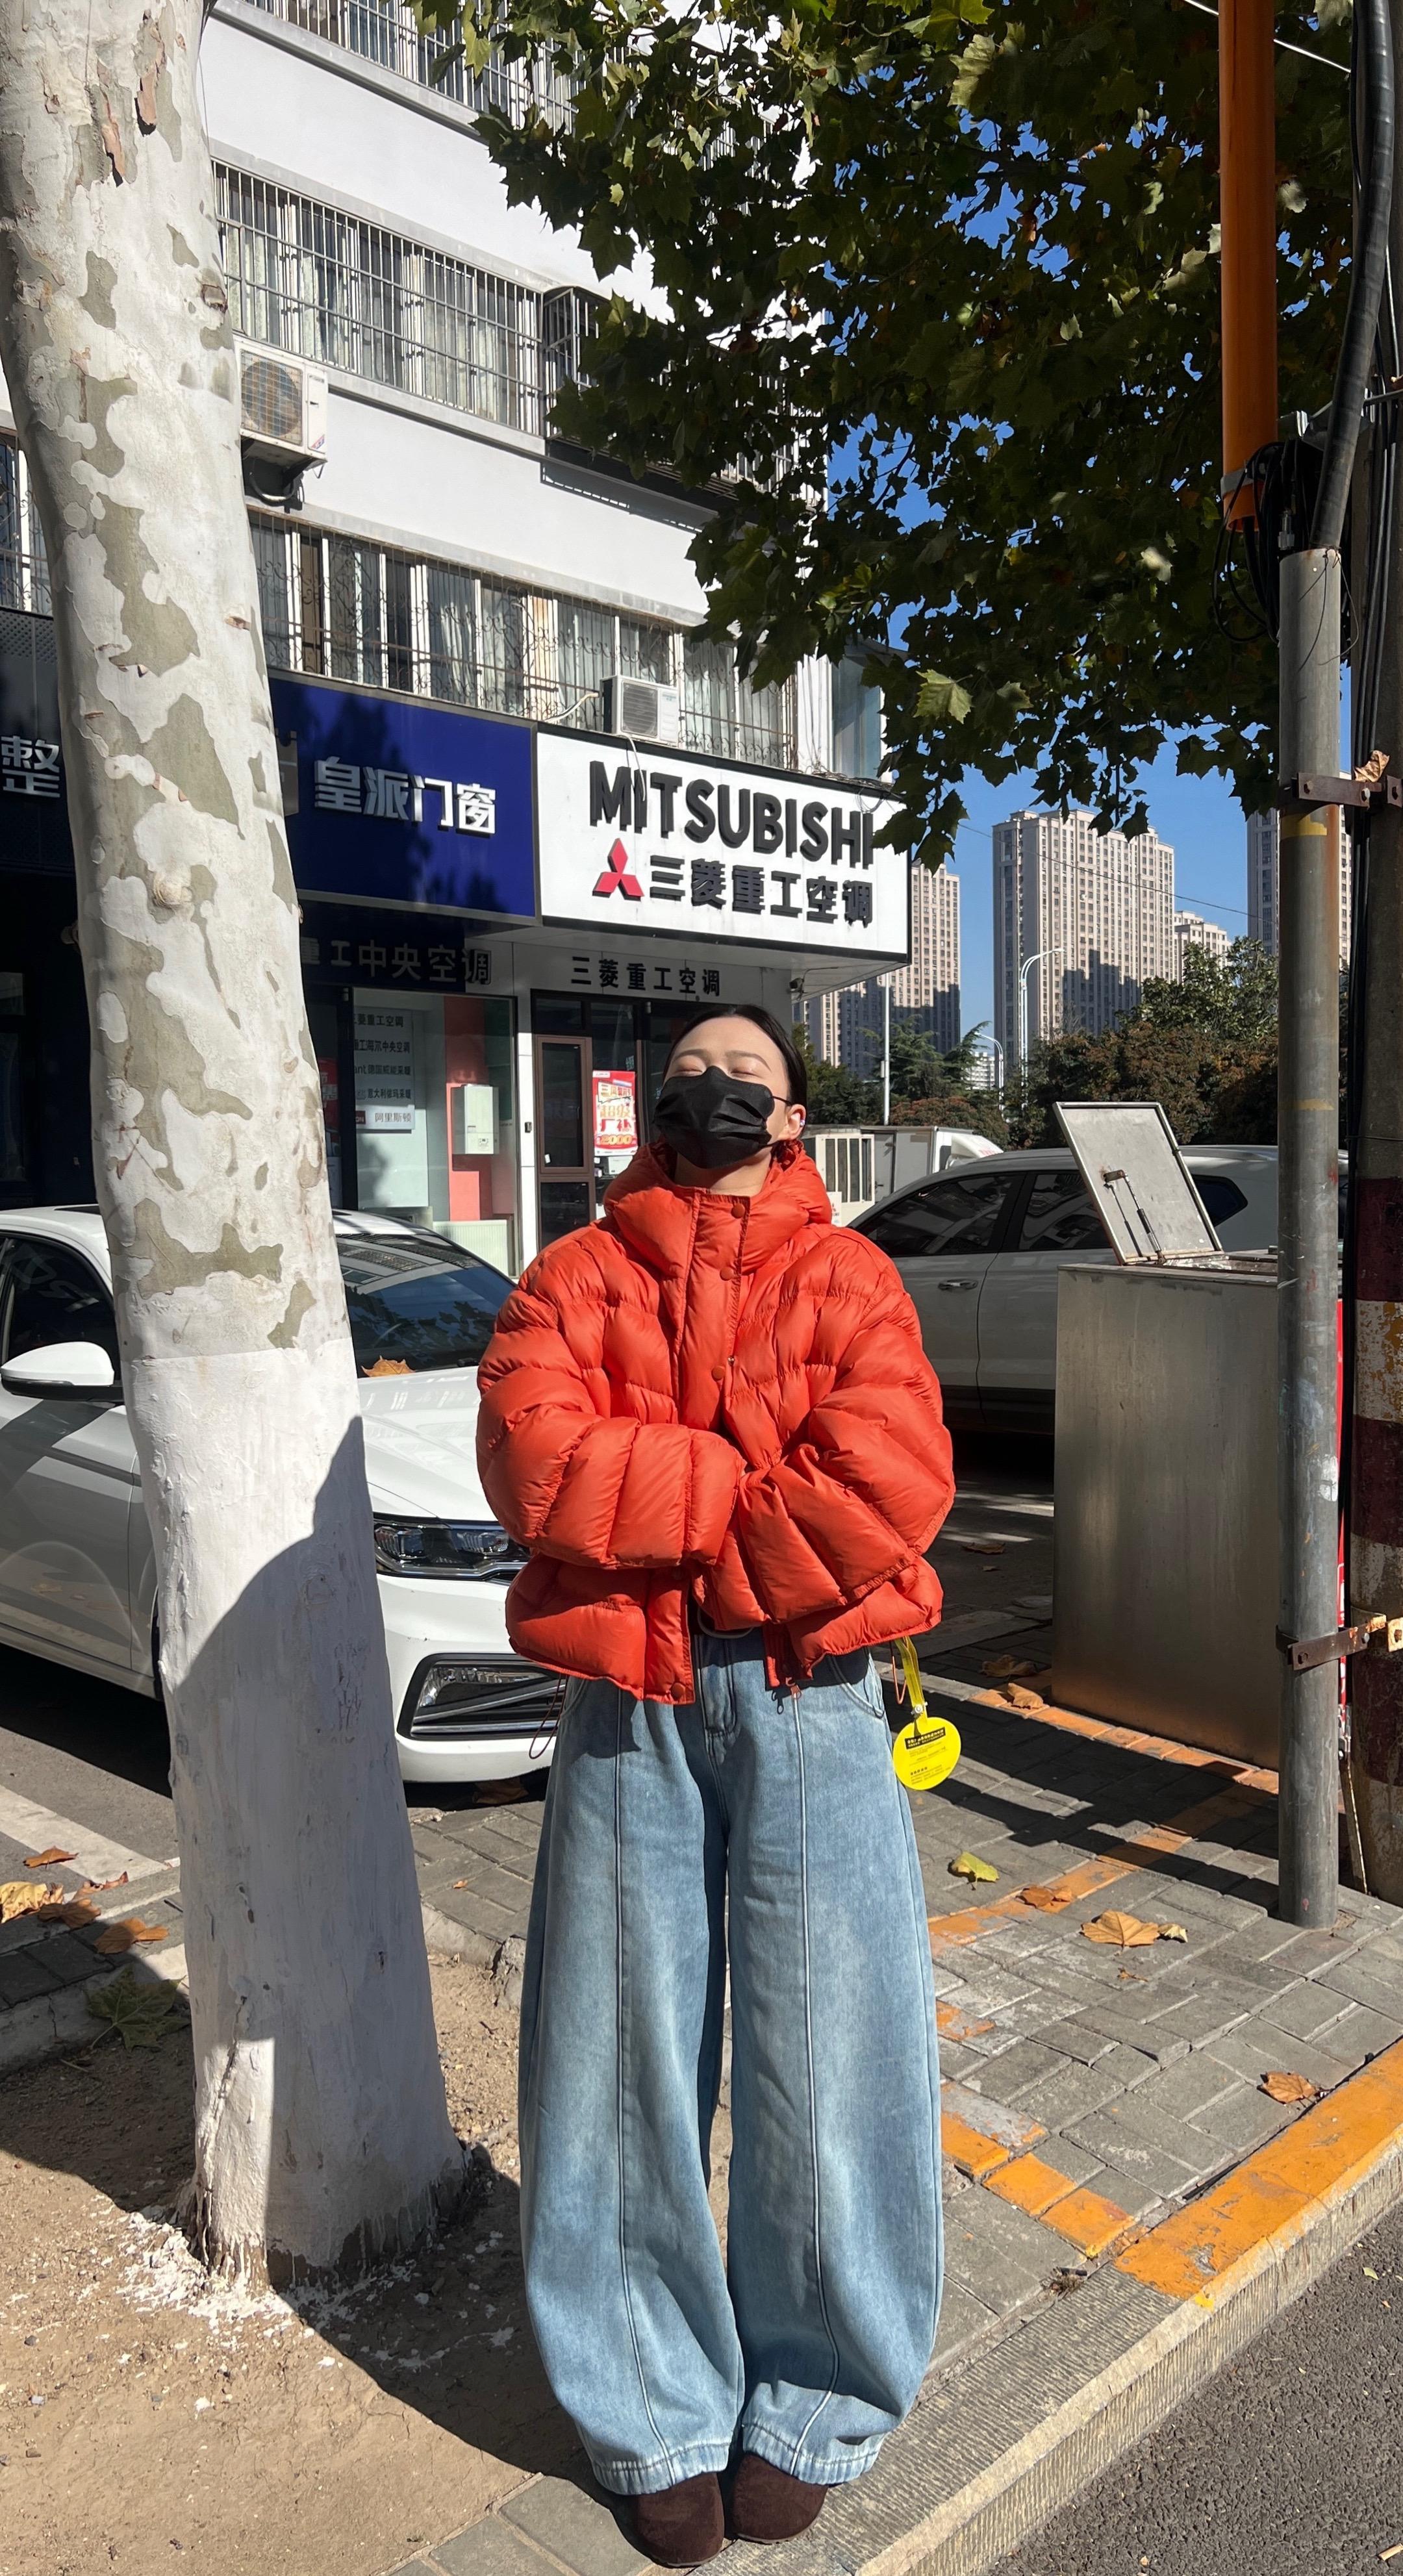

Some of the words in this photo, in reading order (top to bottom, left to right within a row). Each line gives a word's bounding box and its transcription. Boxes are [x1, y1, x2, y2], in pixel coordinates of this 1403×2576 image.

[1, 735, 60, 798] 整
[314, 756, 496, 834] 皇派门窗
[590, 761, 874, 870] MITSUBISHI
[650, 855, 873, 928] 三菱重工空调
[571, 956, 720, 996] 三菱重工空调
